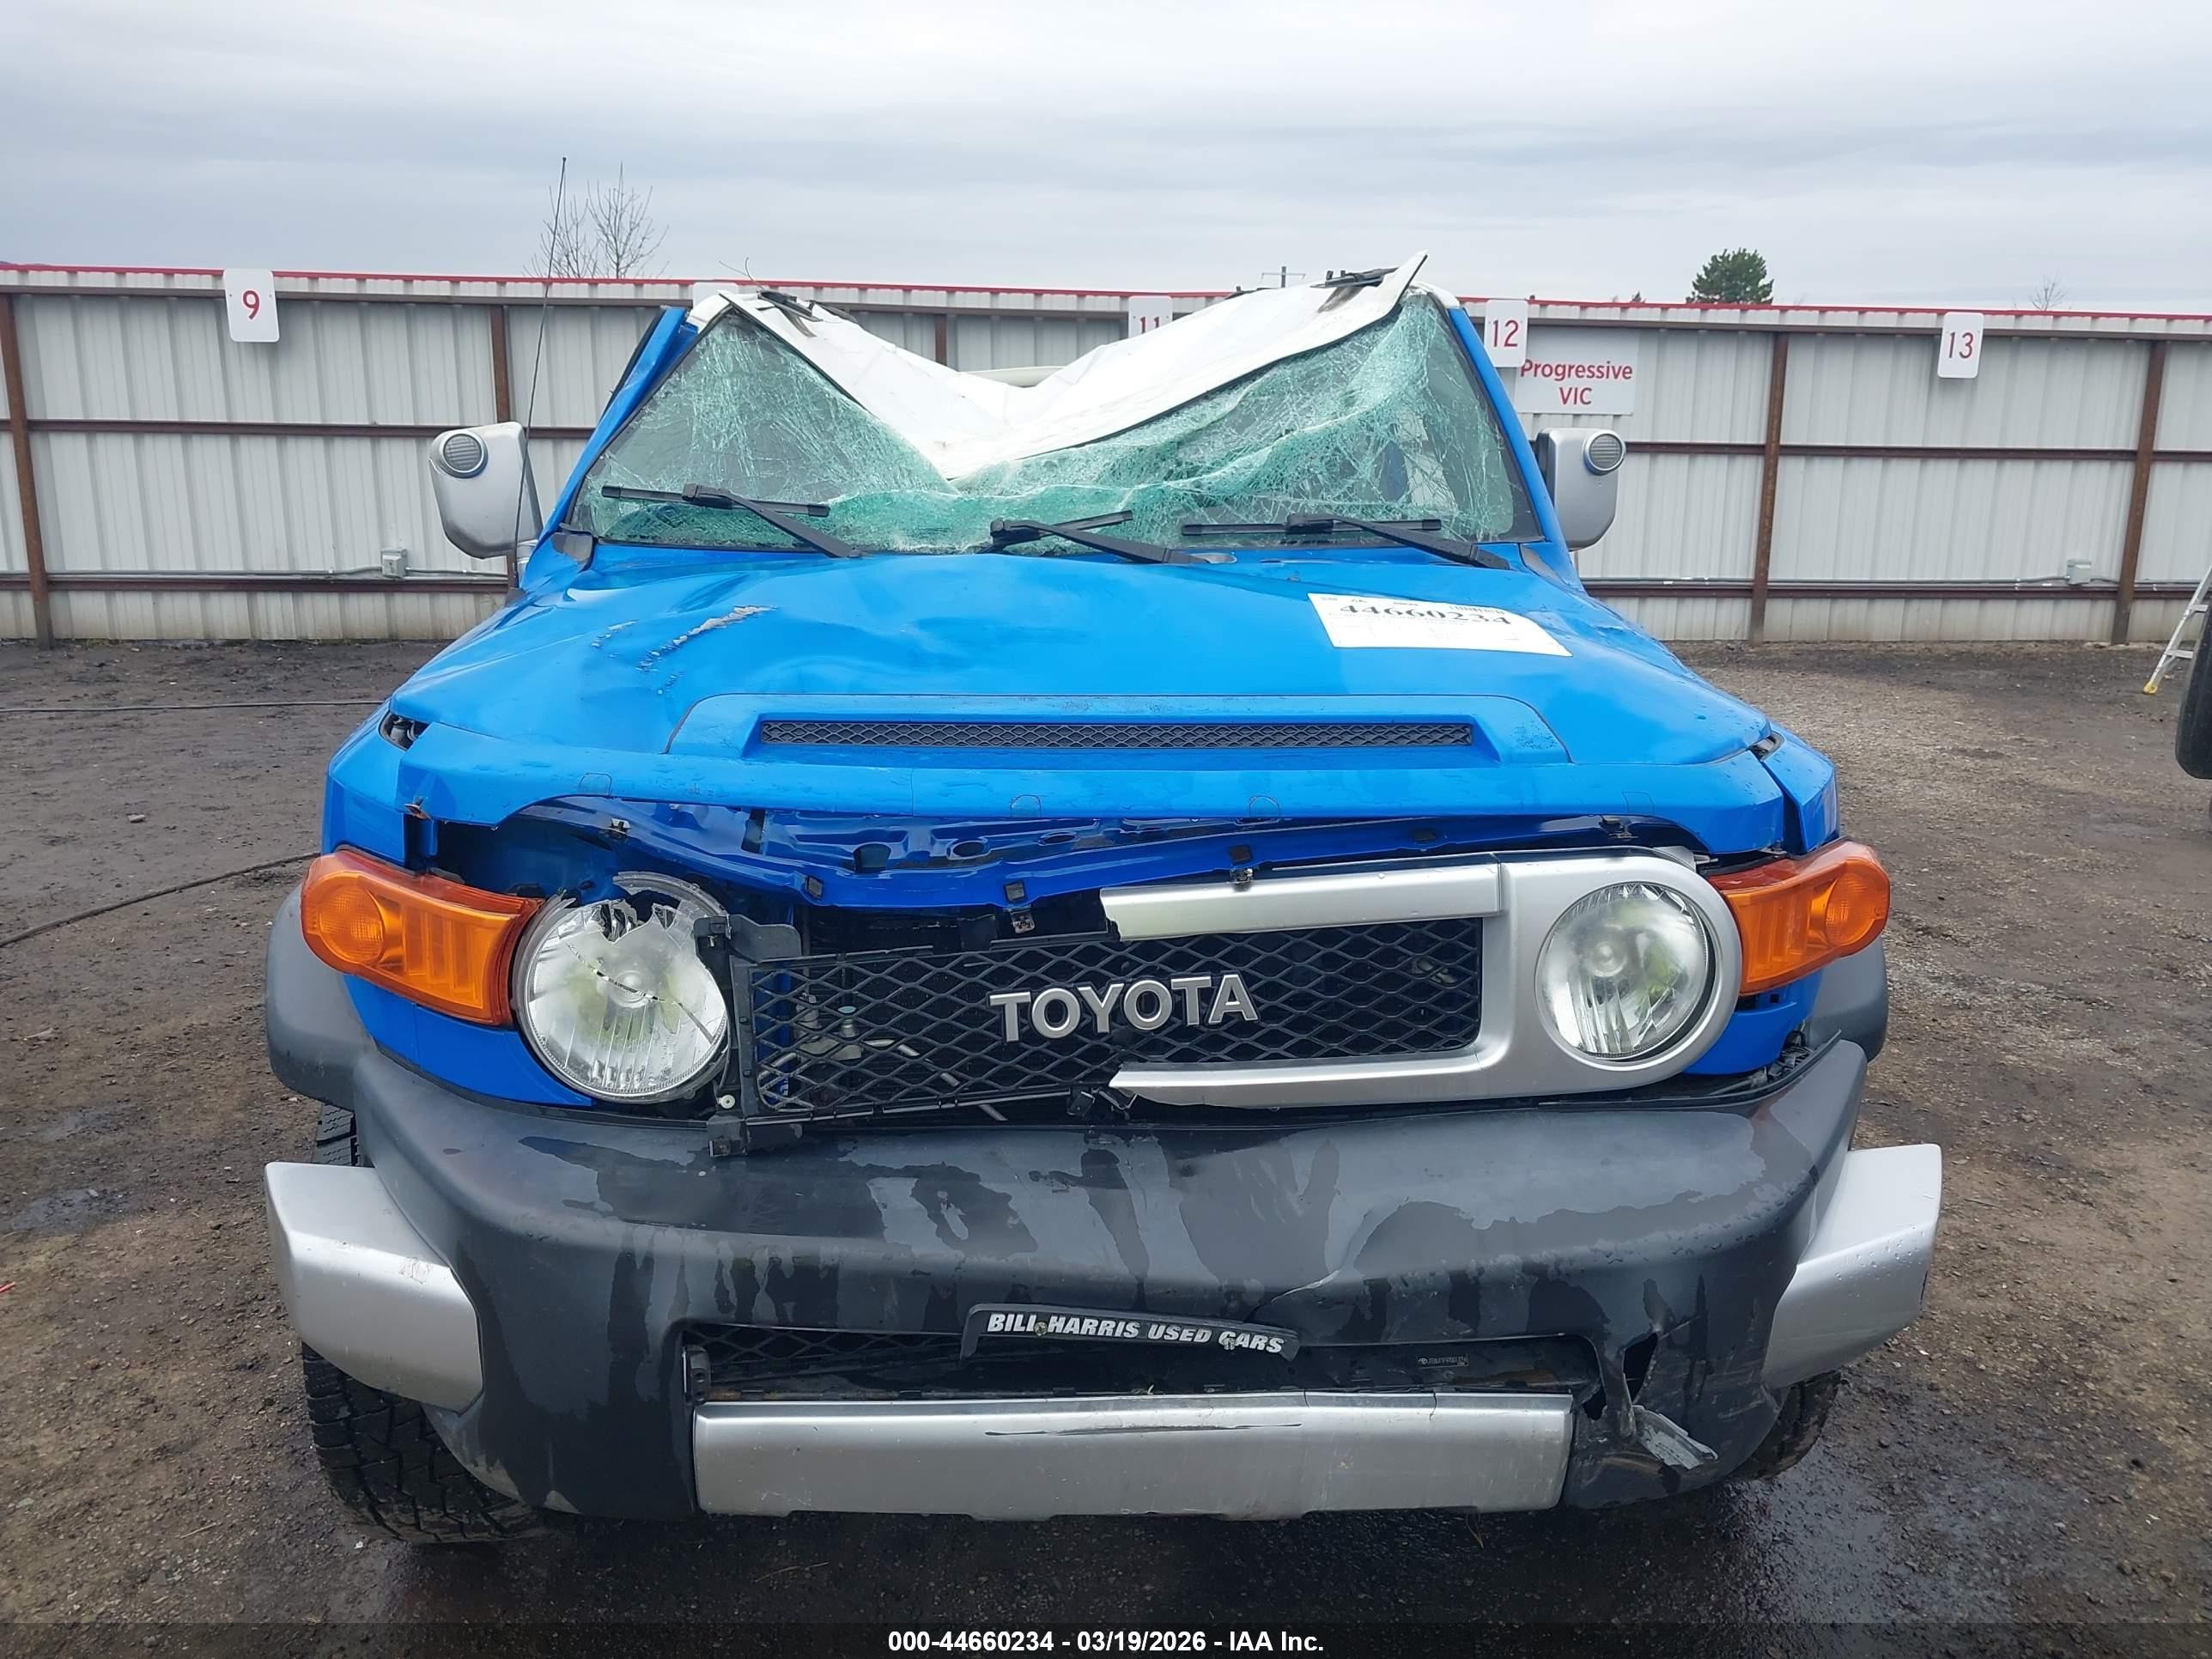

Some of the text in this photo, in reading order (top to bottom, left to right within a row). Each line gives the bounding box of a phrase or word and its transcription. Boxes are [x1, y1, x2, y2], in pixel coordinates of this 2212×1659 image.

[242, 290, 260, 320] 9
[1492, 319, 1519, 347] 12
[1948, 331, 1974, 359] 13
[1520, 358, 1633, 381] Progressive
[1559, 386, 1593, 405] VIC
[1340, 604, 1511, 625] 44660234
[989, 974, 1259, 1042] TOYOTA
[987, 1312, 1285, 1354] BILL HARRIS USED CARS
